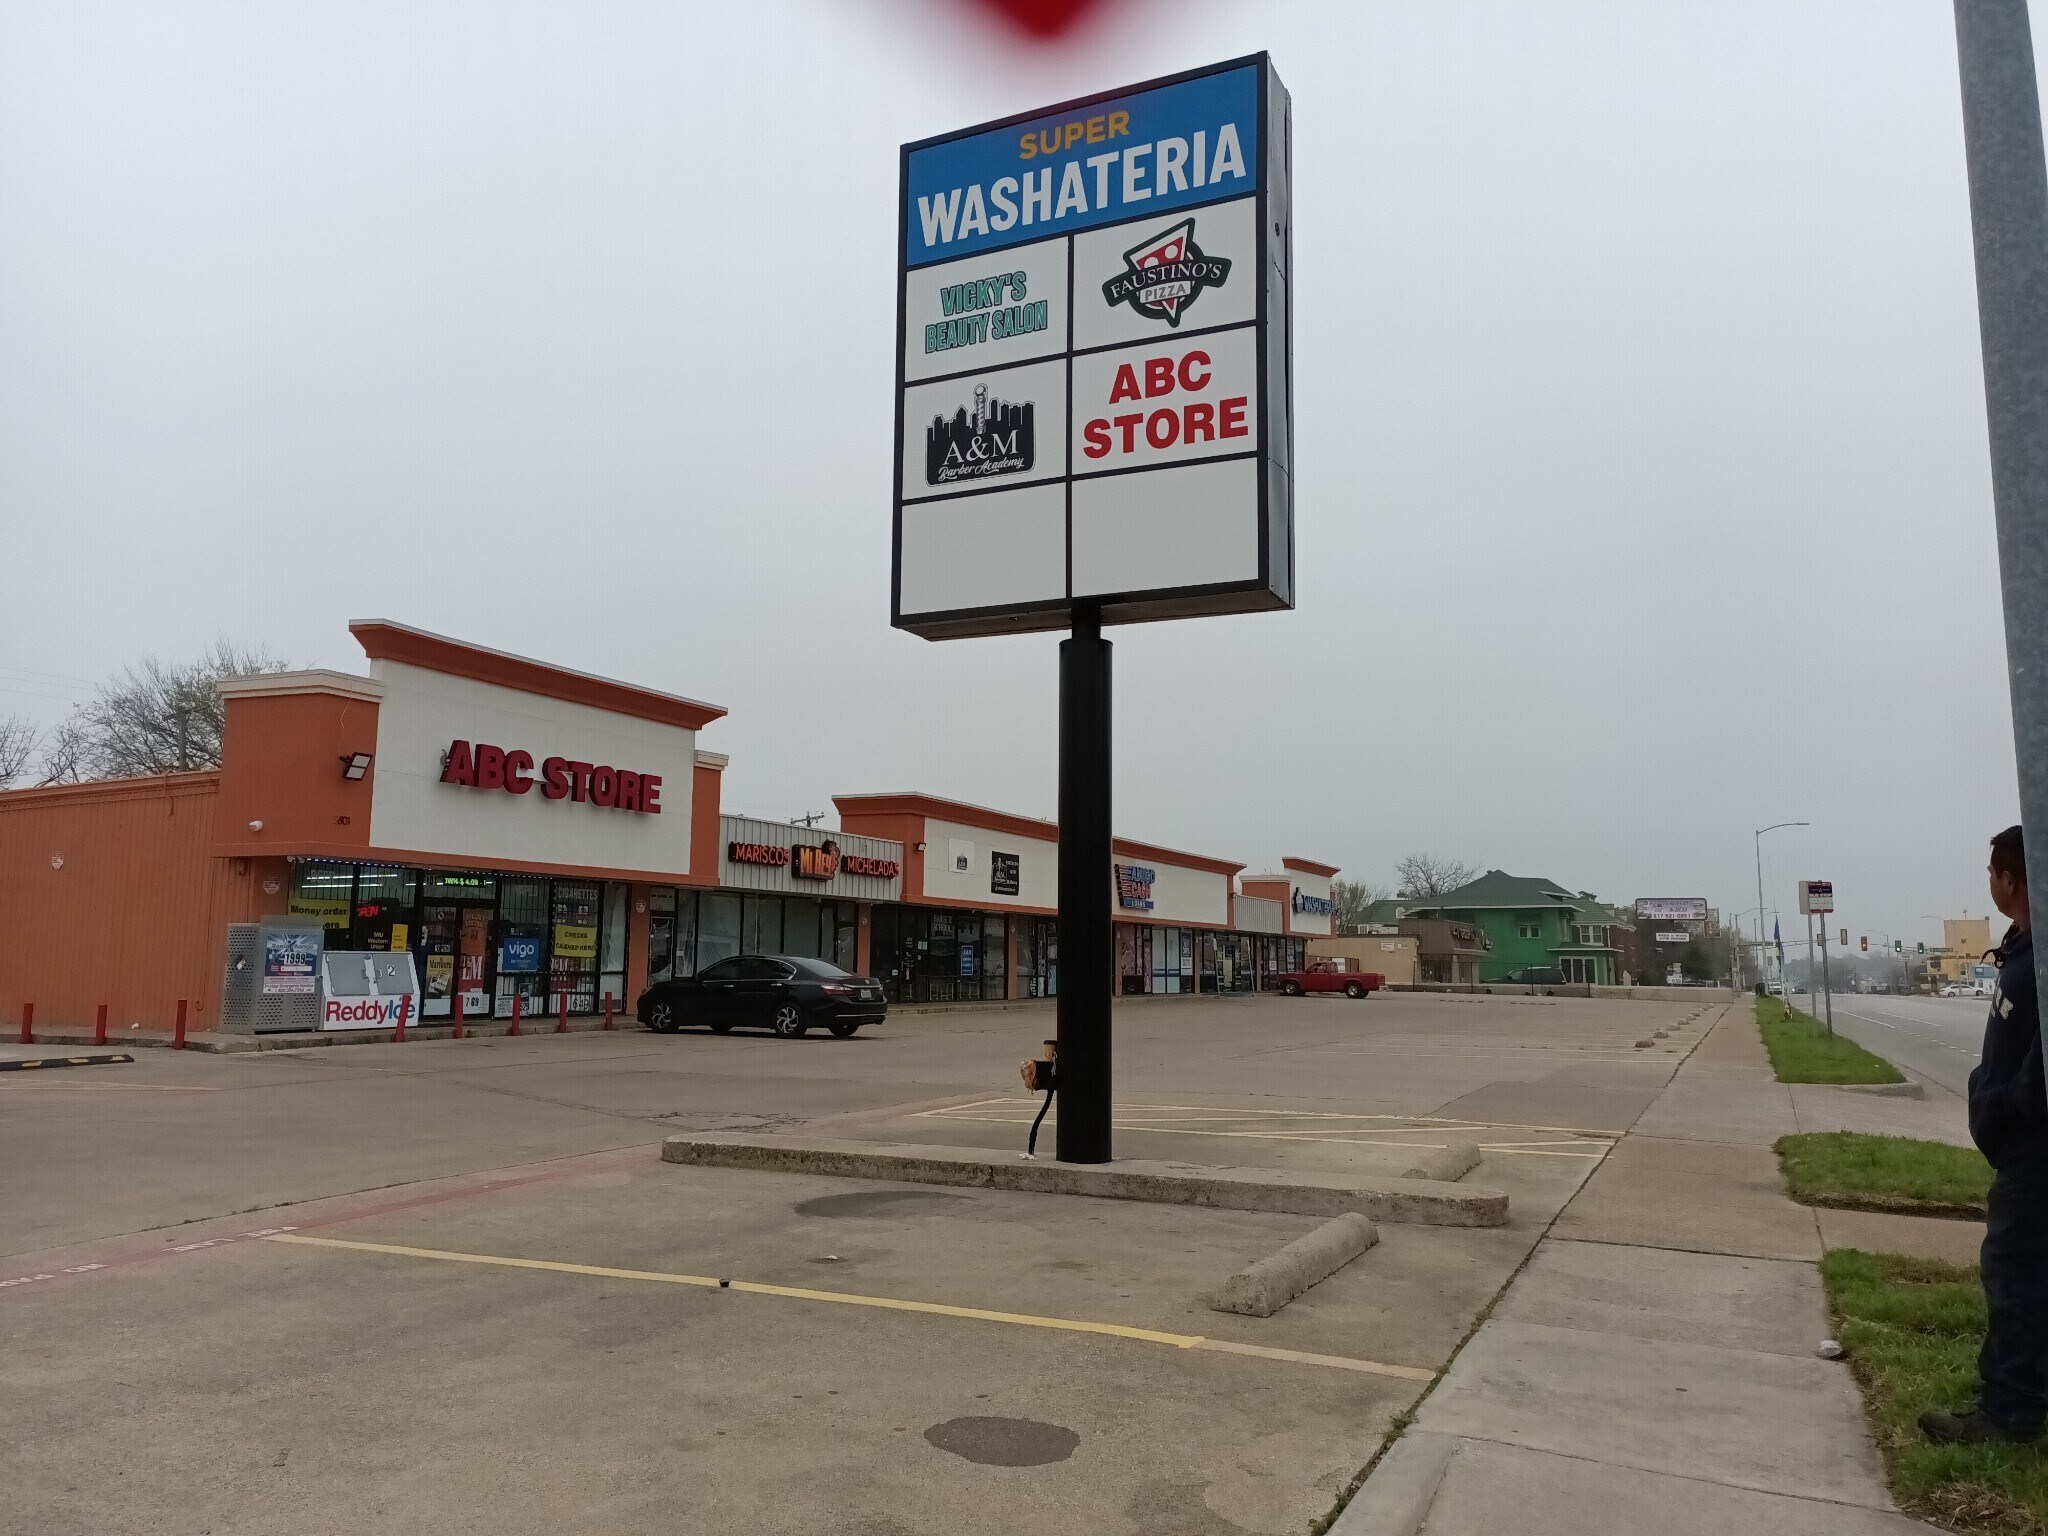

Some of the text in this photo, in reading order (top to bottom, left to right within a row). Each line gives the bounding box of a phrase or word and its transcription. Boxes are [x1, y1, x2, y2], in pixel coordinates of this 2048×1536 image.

[1018, 110, 1130, 160] SUPER
[917, 122, 1247, 247] WASHATERIA
[940, 270, 1027, 317] VICKY'S
[1110, 262, 1222, 299] FAUSTINO'S
[1144, 283, 1187, 301] PIZZA
[925, 300, 1048, 355] BEAUTY SALON
[1108, 350, 1212, 405] ABC
[1083, 396, 1250, 459] STORE
[942, 429, 1019, 466] A&M
[938, 456, 1025, 482] Barber Academy
[440, 739, 663, 814] ABC STORE
[735, 843, 791, 866] MARISCOS
[846, 858, 900, 878] MICHELADAS
[558, 887, 598, 901] CIGARETTES
[1131, 881, 1152, 900] CASH
[290, 904, 348, 917] Money order
[509, 940, 535, 958] vigo
[387, 965, 395, 977] 2
[325, 1000, 416, 1025] ReddyIce
